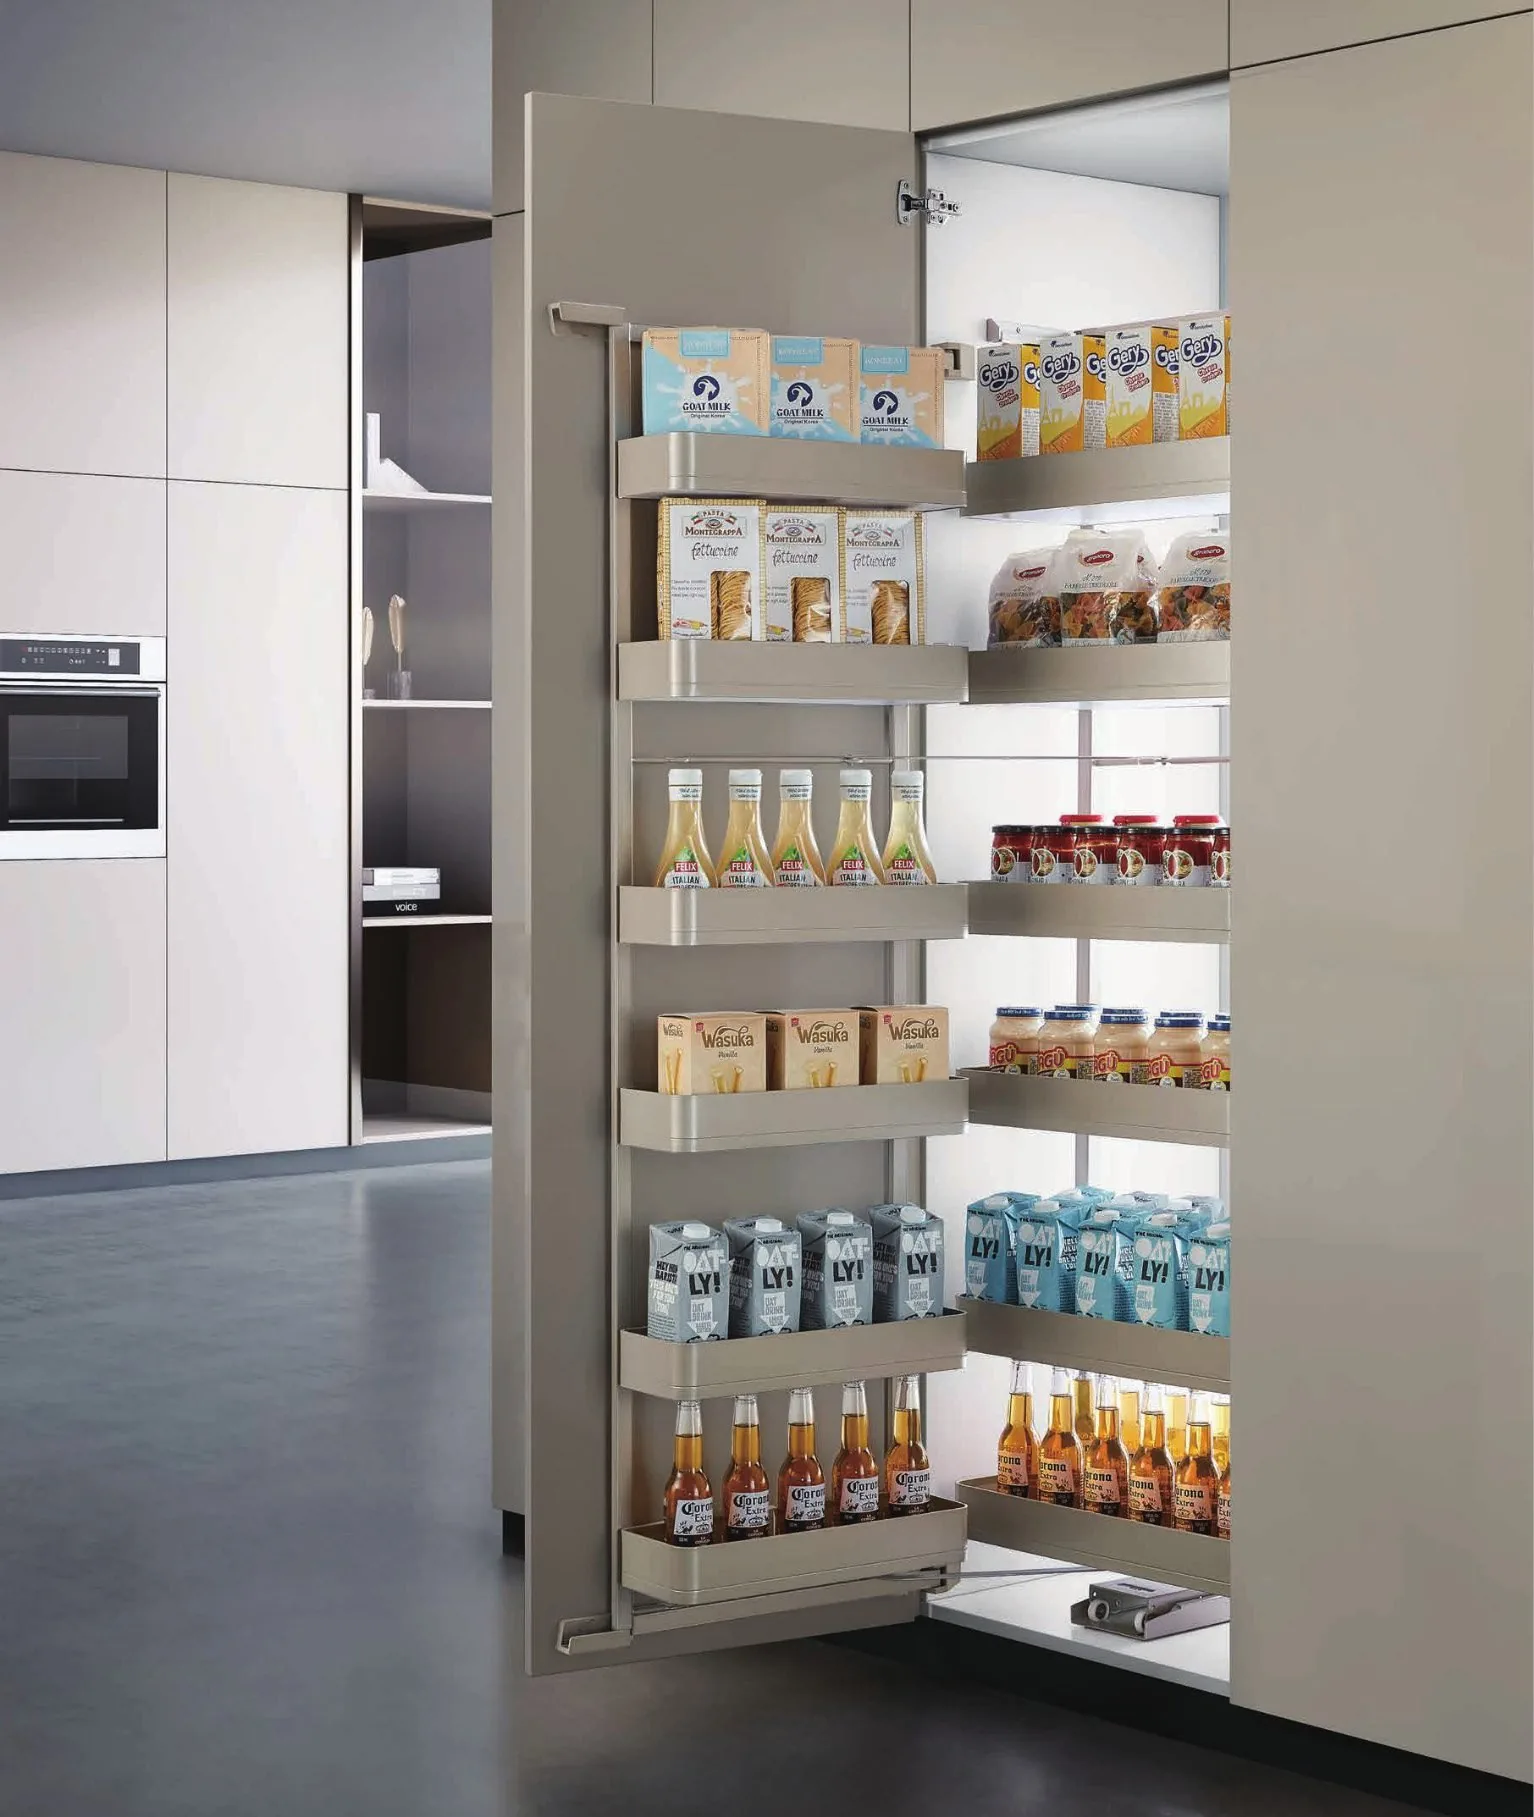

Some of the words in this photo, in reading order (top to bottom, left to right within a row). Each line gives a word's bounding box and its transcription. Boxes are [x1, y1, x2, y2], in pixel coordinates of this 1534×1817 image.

[1181, 334, 1222, 367] Gery
[1108, 344, 1149, 376] Gery
[1155, 344, 1179, 374] Ger
[1042, 352, 1080, 384] Gery
[980, 361, 1019, 392] Gery
[682, 403, 706, 411] GOAT
[708, 403, 731, 411] MILK
[776, 408, 800, 417] GOAT
[802, 408, 824, 417] MILK
[691, 542, 739, 560] fettuccine
[773, 549, 818, 567] fettuccine
[675, 862, 697, 871] FELIX
[732, 862, 753, 871] FELIX
[782, 861, 803, 870] FELIX
[843, 860, 864, 869] FELIX
[894, 860, 914, 868] FELIX
[672, 876, 700, 884] ITALIAN
[729, 875, 755, 884] ITALIAN
[779, 873, 806, 882] ITALIAN
[840, 873, 867, 881] ITALIAN
[890, 872, 918, 881] ITALIAN
[395, 902, 418, 911] voice
[796, 1021, 849, 1044] Wasuka
[889, 1017, 939, 1041] Wasuka
[701, 1025, 754, 1048] Wasuka
[971, 1236, 1000, 1260] LY!
[1024, 1244, 1052, 1268] LY!
[906, 1252, 937, 1275] LY!
[1084, 1252, 1110, 1276] LY!
[832, 1259, 865, 1282] LY!
[1141, 1260, 1169, 1284] LY!
[688, 1271, 721, 1295] LY!
[762, 1266, 793, 1289] LY!
[1195, 1268, 1225, 1292] LY!
[1040, 1461, 1067, 1472] orona
[1040, 1470, 1058, 1481] Extra
[1084, 1471, 1112, 1482] orona
[908, 1484, 927, 1493] Extra
[1085, 1480, 1103, 1491] Extra
[791, 1488, 825, 1501] Coron
[1176, 1488, 1204, 1499] orona
[1176, 1496, 1195, 1507] Extra
